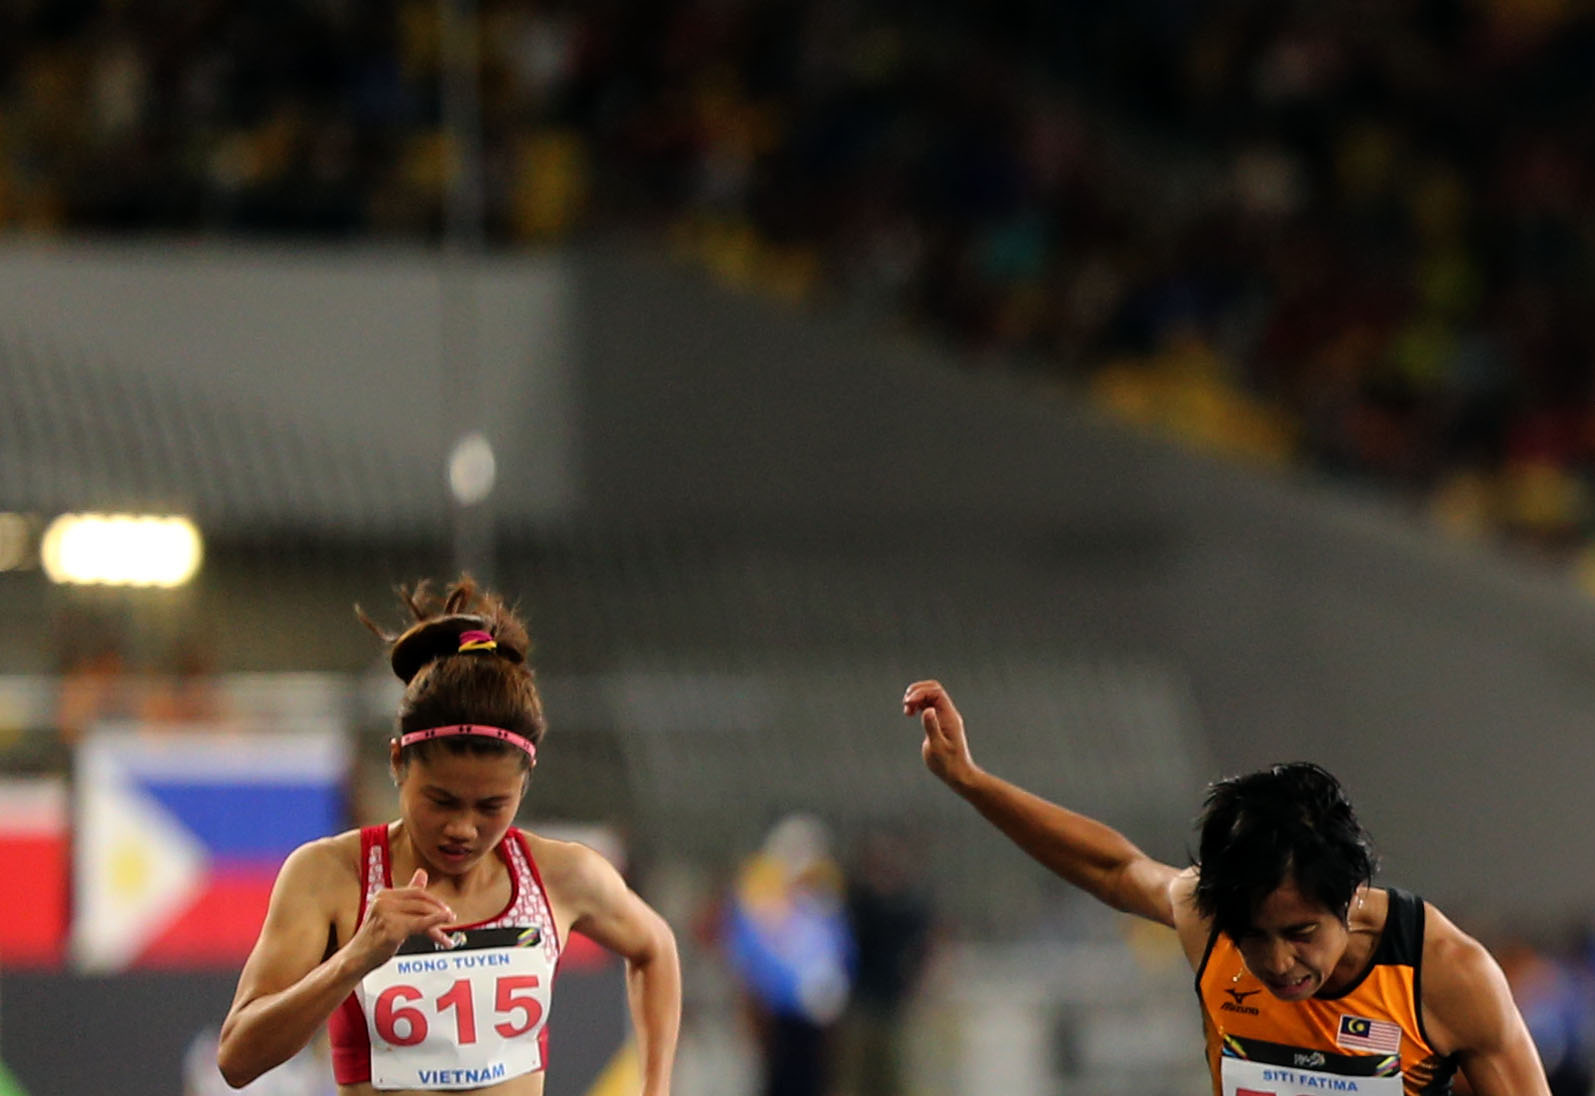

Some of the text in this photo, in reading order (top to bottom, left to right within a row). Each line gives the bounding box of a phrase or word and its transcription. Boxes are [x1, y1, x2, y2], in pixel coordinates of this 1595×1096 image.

[398, 954, 510, 974] MONG TUYEN
[374, 975, 542, 1046] 615
[418, 1064, 505, 1084] VIETNAM
[1263, 1070, 1358, 1092] SITI FATIMA
